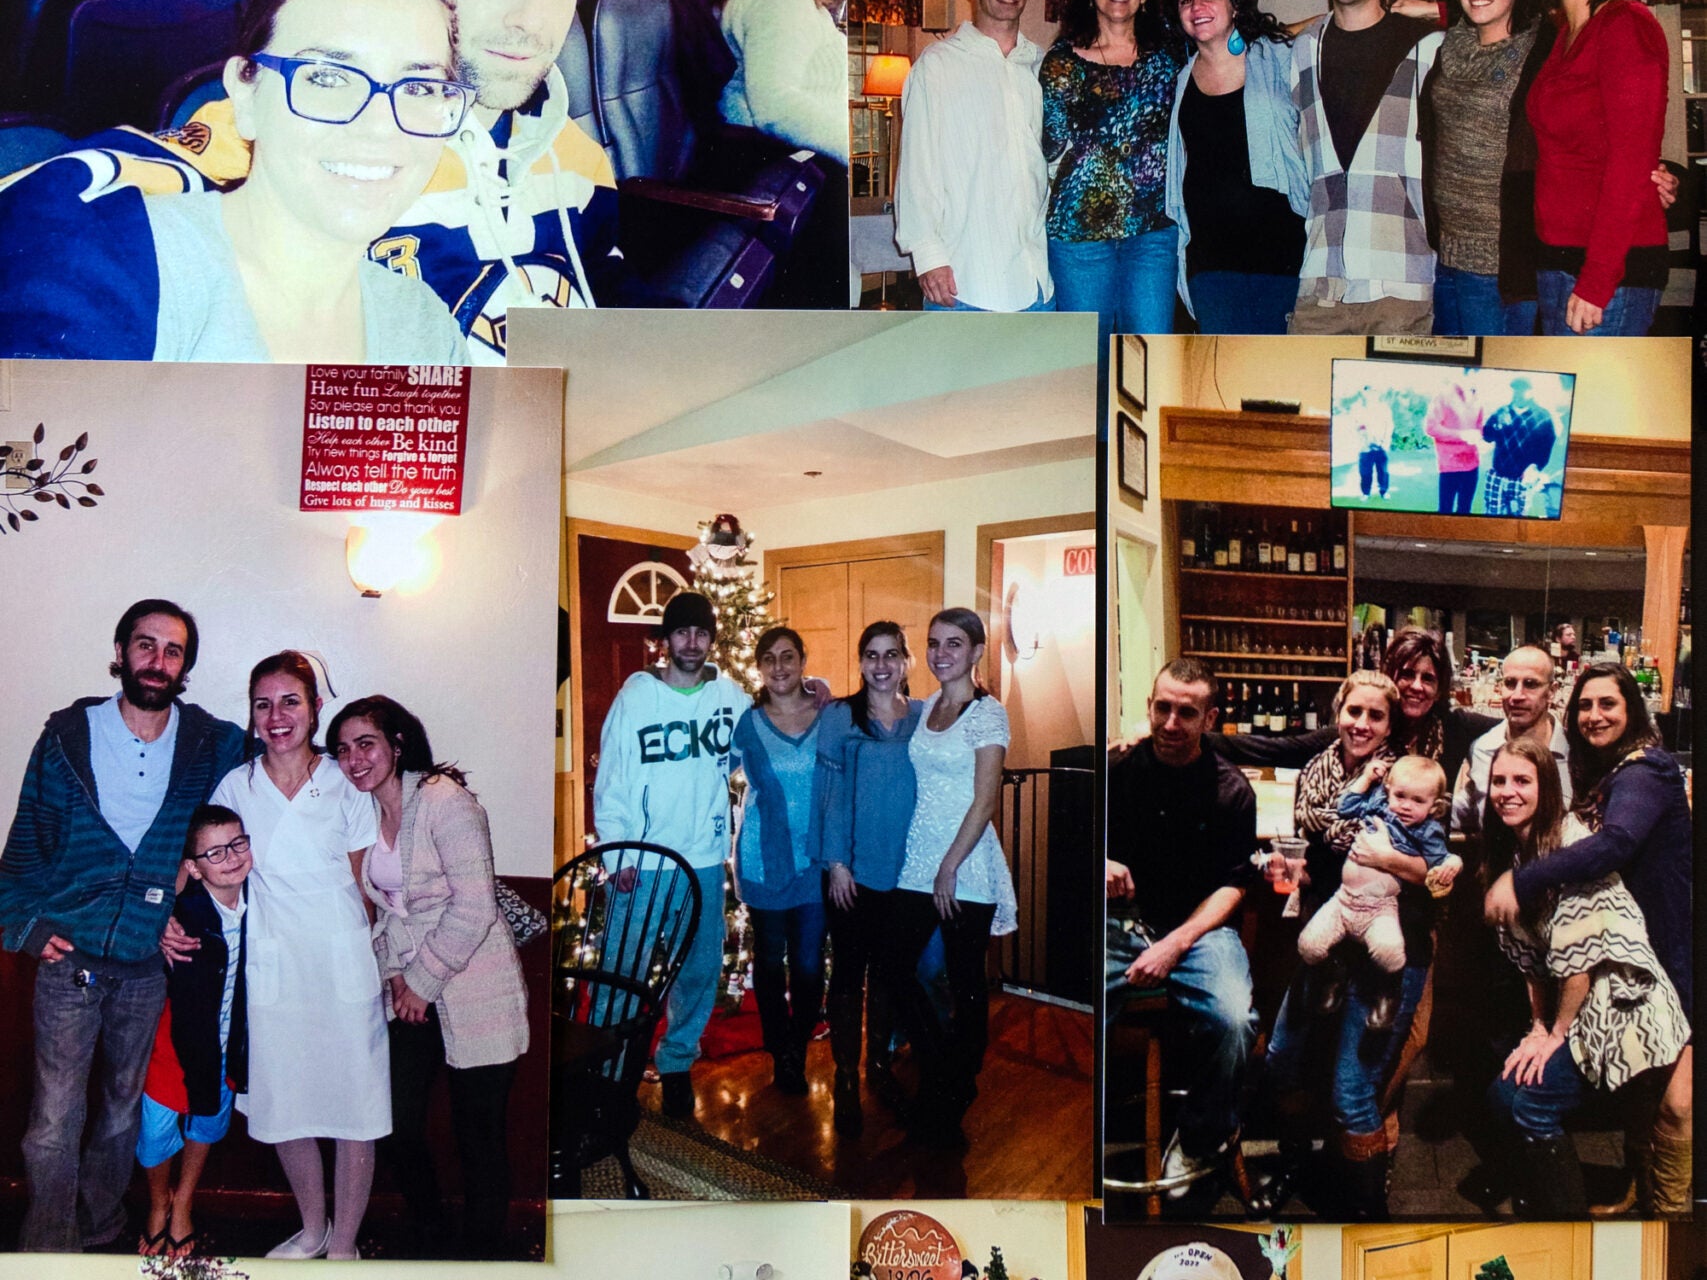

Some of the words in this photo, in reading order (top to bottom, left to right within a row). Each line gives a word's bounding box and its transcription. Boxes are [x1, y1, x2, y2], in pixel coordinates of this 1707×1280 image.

[1399, 336, 1437, 348] ANDREWS
[311, 366, 338, 378] Love
[342, 369, 366, 380] your
[371, 367, 407, 382] family
[408, 365, 463, 386] SHARE
[310, 381, 349, 396] Have
[353, 381, 379, 397] fun
[382, 383, 420, 403] Laugh
[421, 387, 461, 403] together
[310, 399, 331, 412] Say
[334, 401, 373, 412] please
[377, 402, 401, 413] and
[404, 403, 436, 414] thank
[440, 405, 461, 416] you
[308, 413, 354, 430] Listen
[358, 415, 373, 430] to
[376, 416, 414, 432] each
[418, 417, 459, 433] other
[308, 431, 338, 448] Help
[341, 434, 363, 445] each
[365, 435, 390, 446] other
[392, 432, 414, 450] Be
[418, 433, 458, 452] kind
[307, 446, 321, 458] Try
[324, 448, 346, 457] new
[349, 448, 380, 461] things
[382, 450, 418, 463] Forgive
[419, 452, 426, 462] &
[428, 453, 457, 464] forget
[305, 461, 359, 480] Always
[364, 462, 386, 478] tell
[391, 463, 418, 479] the
[422, 464, 456, 480] truth
[304, 479, 340, 492] Respect
[341, 480, 362, 492] each
[364, 481, 387, 493] other
[390, 480, 408, 494] Do
[409, 487, 434, 499] your
[436, 483, 456, 496] best
[304, 494, 328, 506] Give
[332, 495, 352, 506] lots
[354, 495, 368, 507] of
[369, 496, 396, 511] hugs
[399, 497, 420, 508] and
[423, 497, 454, 509] kisses
[861, 1240, 954, 1268] Bittersweet
[1188, 1248, 1213, 1261] OPEN
